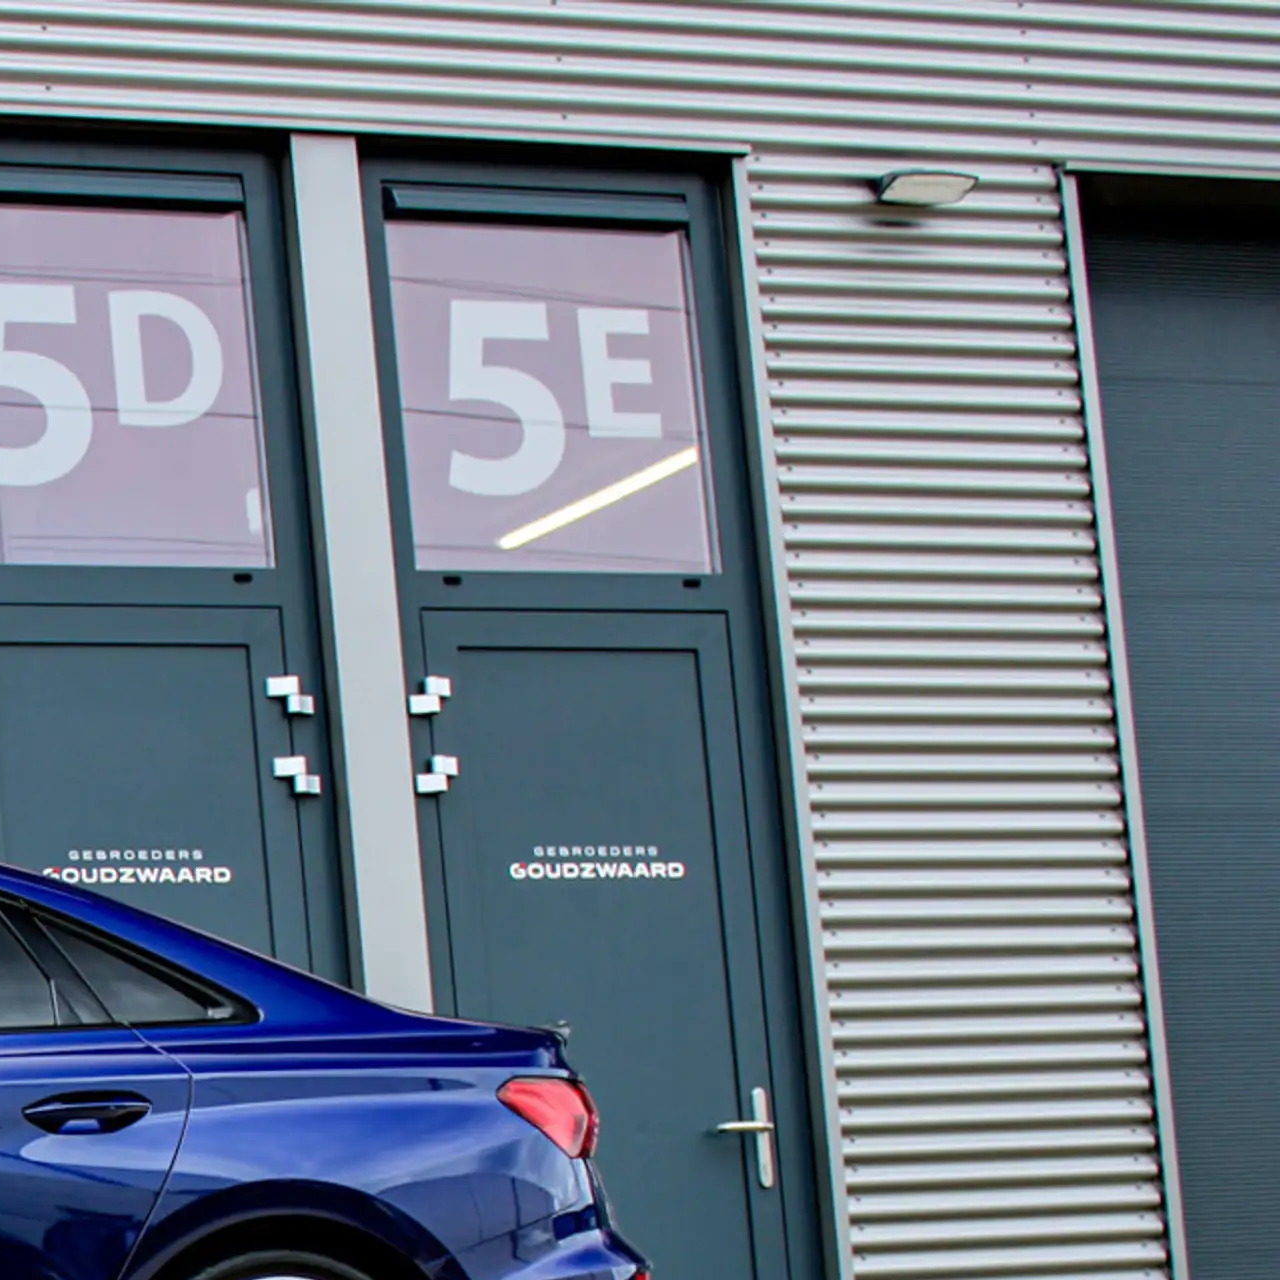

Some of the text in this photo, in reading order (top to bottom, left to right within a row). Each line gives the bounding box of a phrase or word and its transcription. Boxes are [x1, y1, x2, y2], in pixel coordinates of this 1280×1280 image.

[449, 299, 663, 496] 5E
[68, 850, 203, 861] GEBROEDERS
[533, 846, 658, 858] GEBROEDERS
[509, 862, 686, 880] GOUDZWAARD
